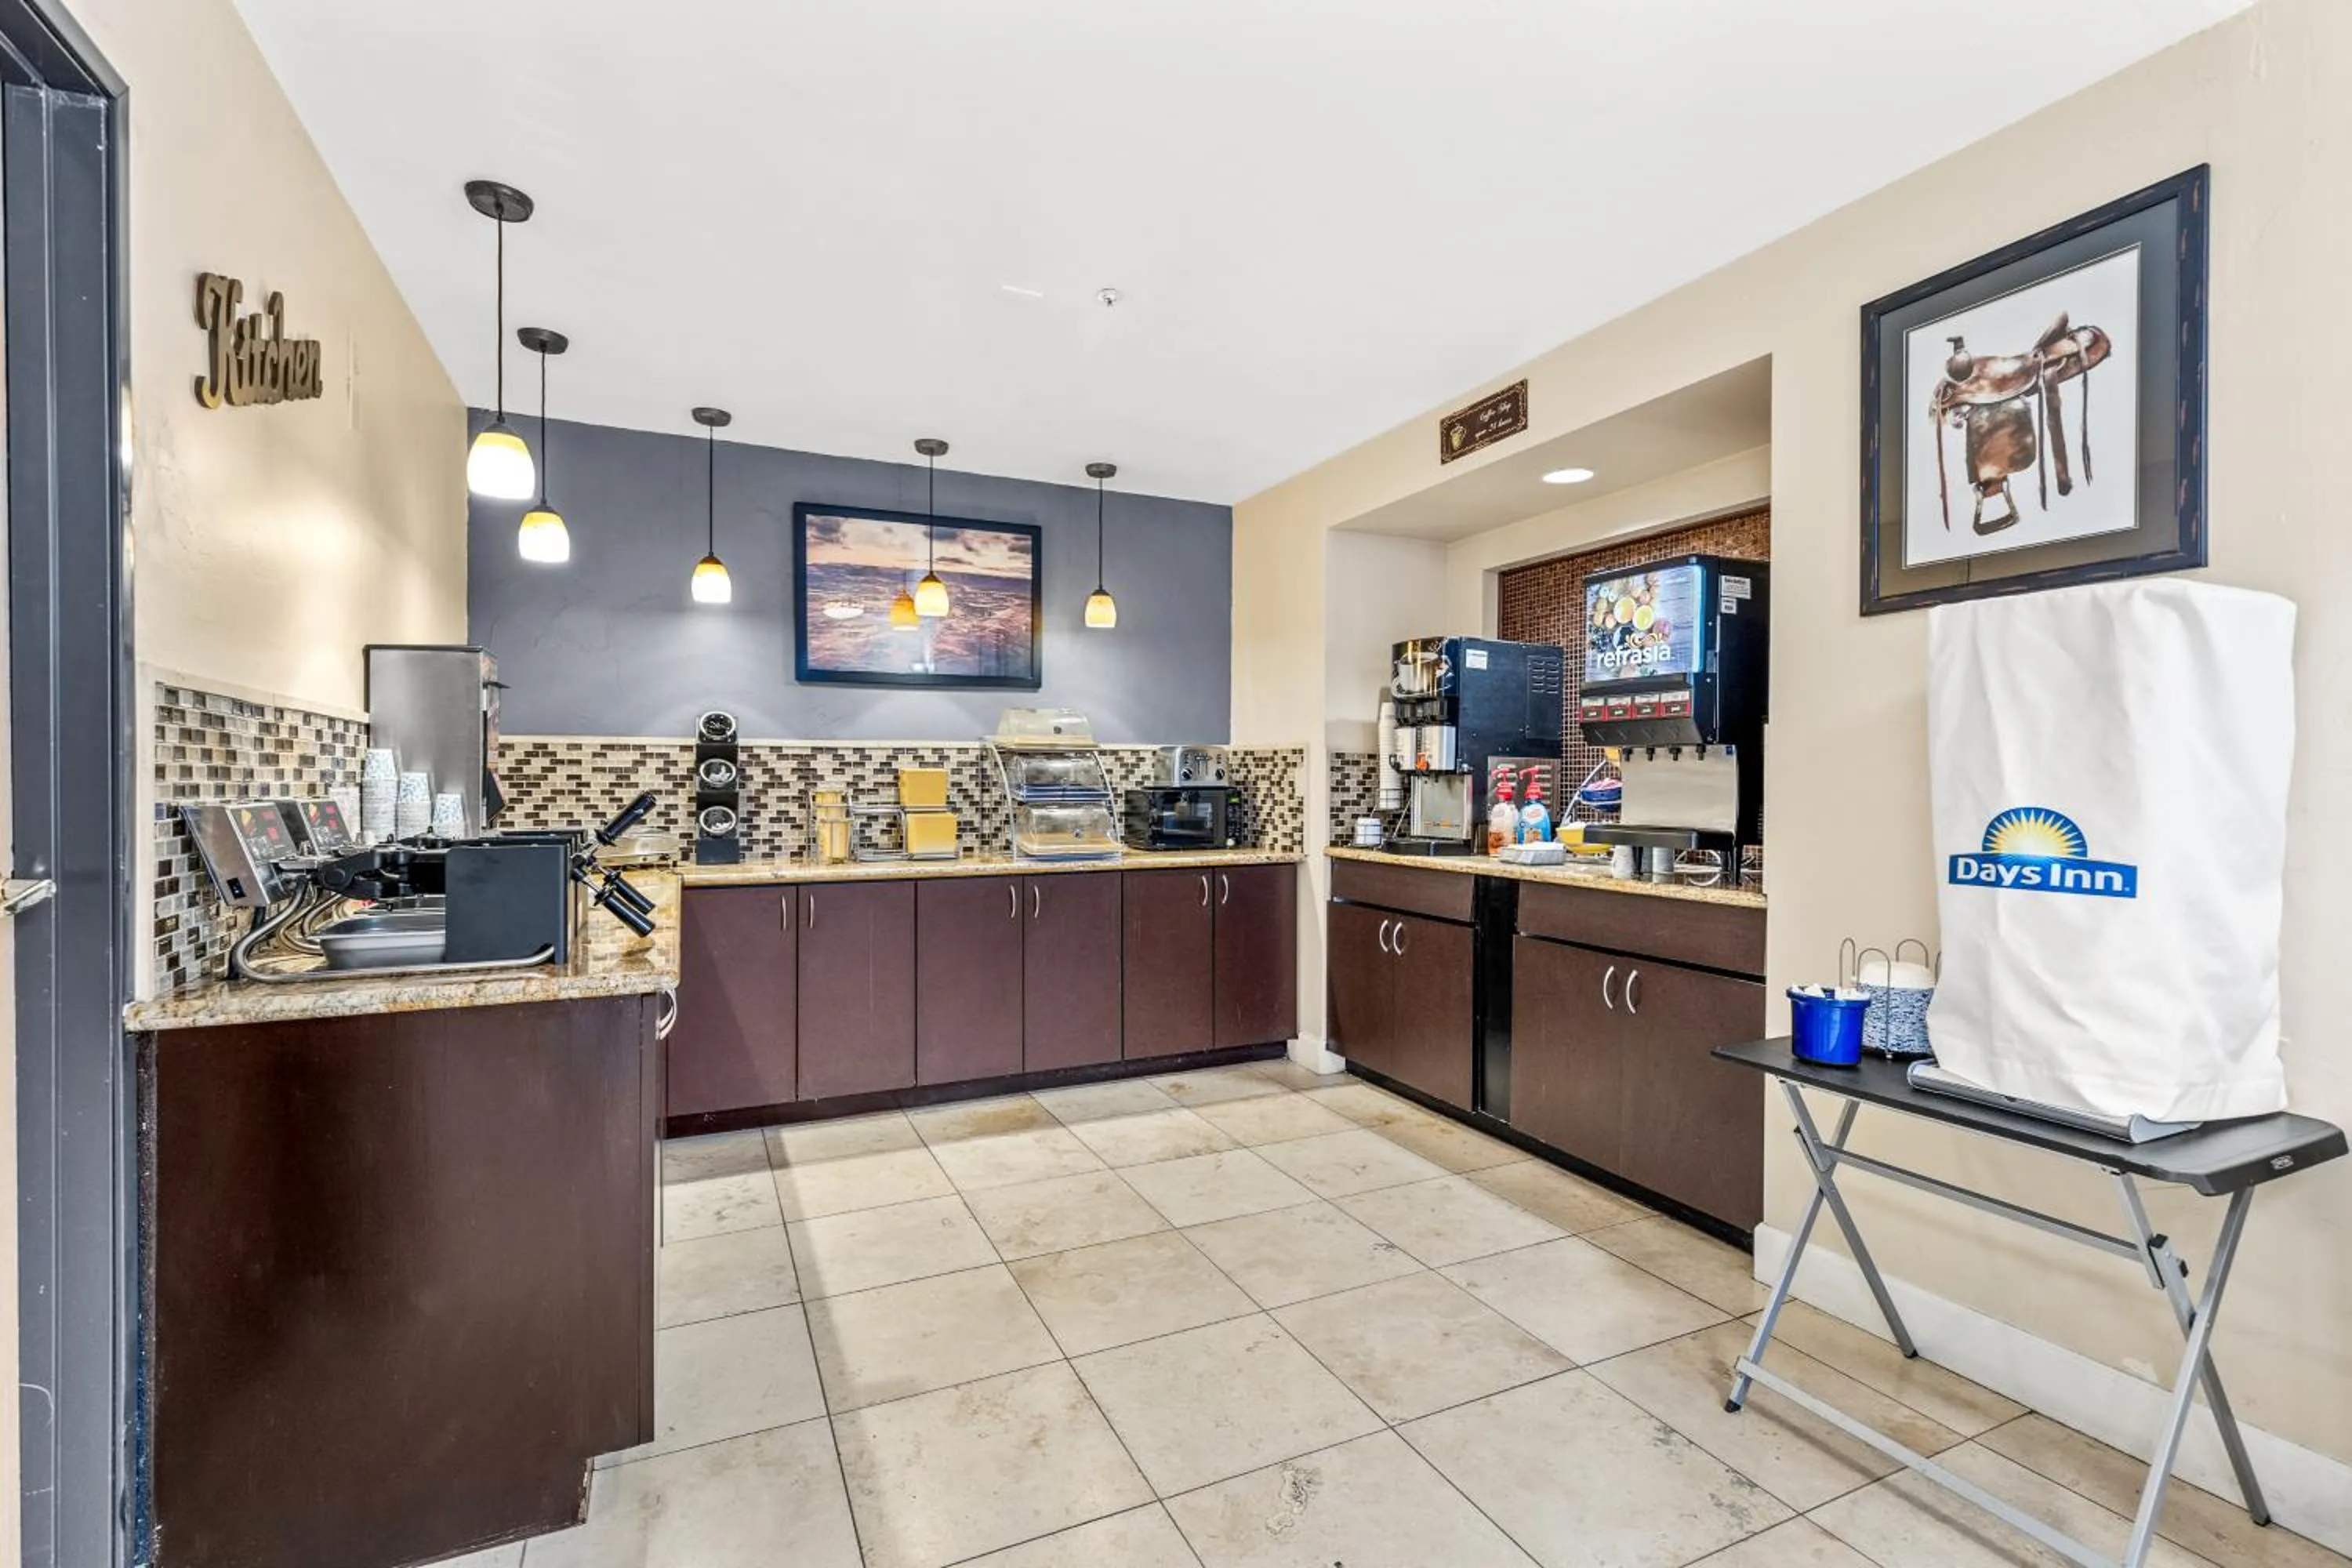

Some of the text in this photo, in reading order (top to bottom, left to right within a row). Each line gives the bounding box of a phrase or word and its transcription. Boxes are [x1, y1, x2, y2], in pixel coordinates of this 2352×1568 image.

[194, 272, 323, 409] Kitchen
[1956, 857, 2123, 892] Days Inn
